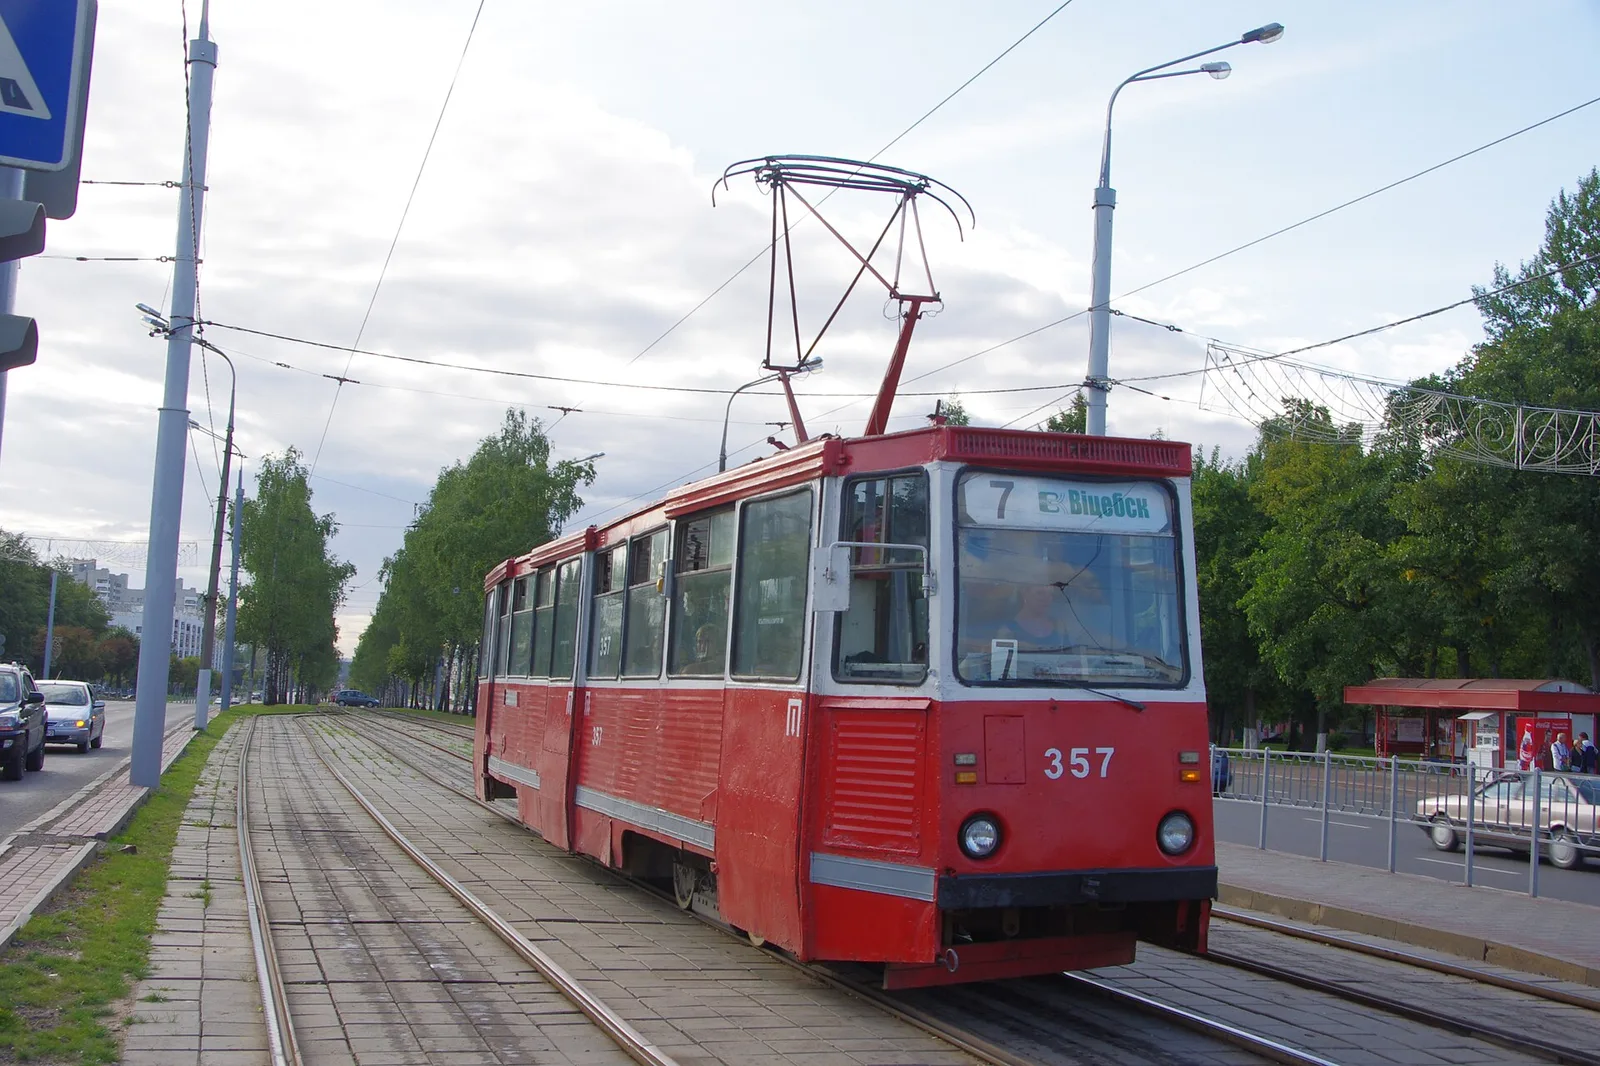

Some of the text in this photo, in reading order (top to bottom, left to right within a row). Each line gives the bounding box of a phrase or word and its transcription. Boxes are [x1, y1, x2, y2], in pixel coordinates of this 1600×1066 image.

[990, 480, 1015, 520] 7
[1068, 488, 1150, 519] Віцебск
[600, 635, 612, 657] 357
[995, 641, 1015, 681] 7
[592, 726, 603, 746] 357
[1043, 746, 1115, 780] 357
